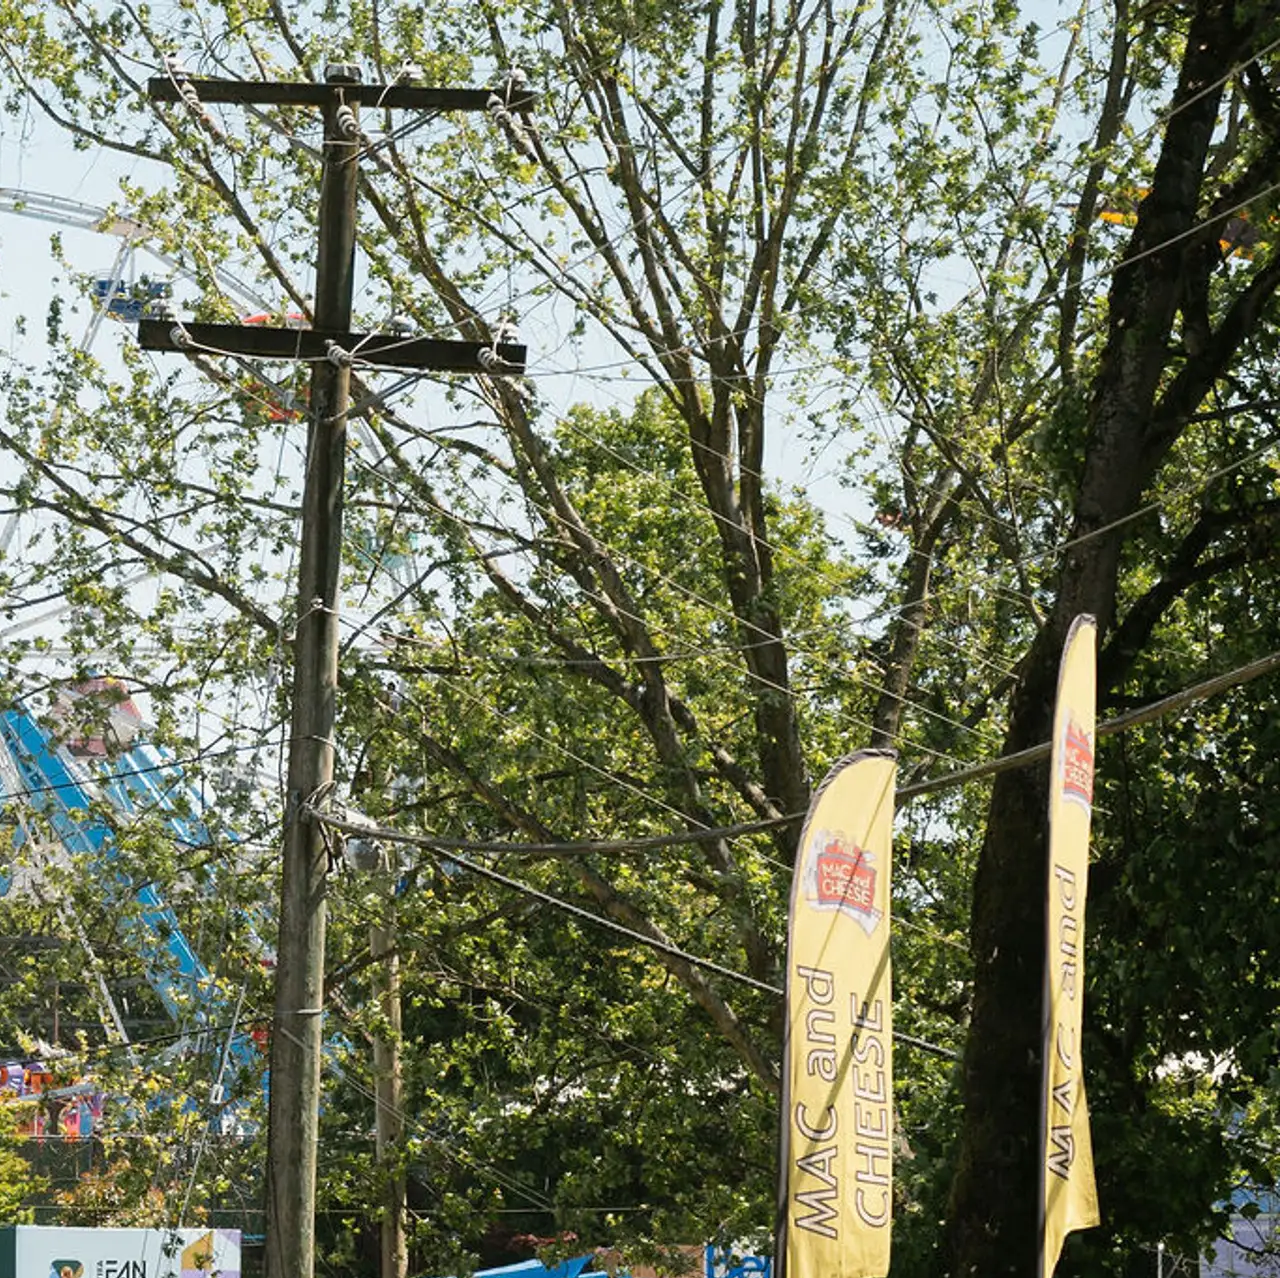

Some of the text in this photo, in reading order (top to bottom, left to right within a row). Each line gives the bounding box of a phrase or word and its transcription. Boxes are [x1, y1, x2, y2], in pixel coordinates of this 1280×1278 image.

[794, 965, 839, 1240] MAC and
[851, 992, 891, 1229] CHEESE
